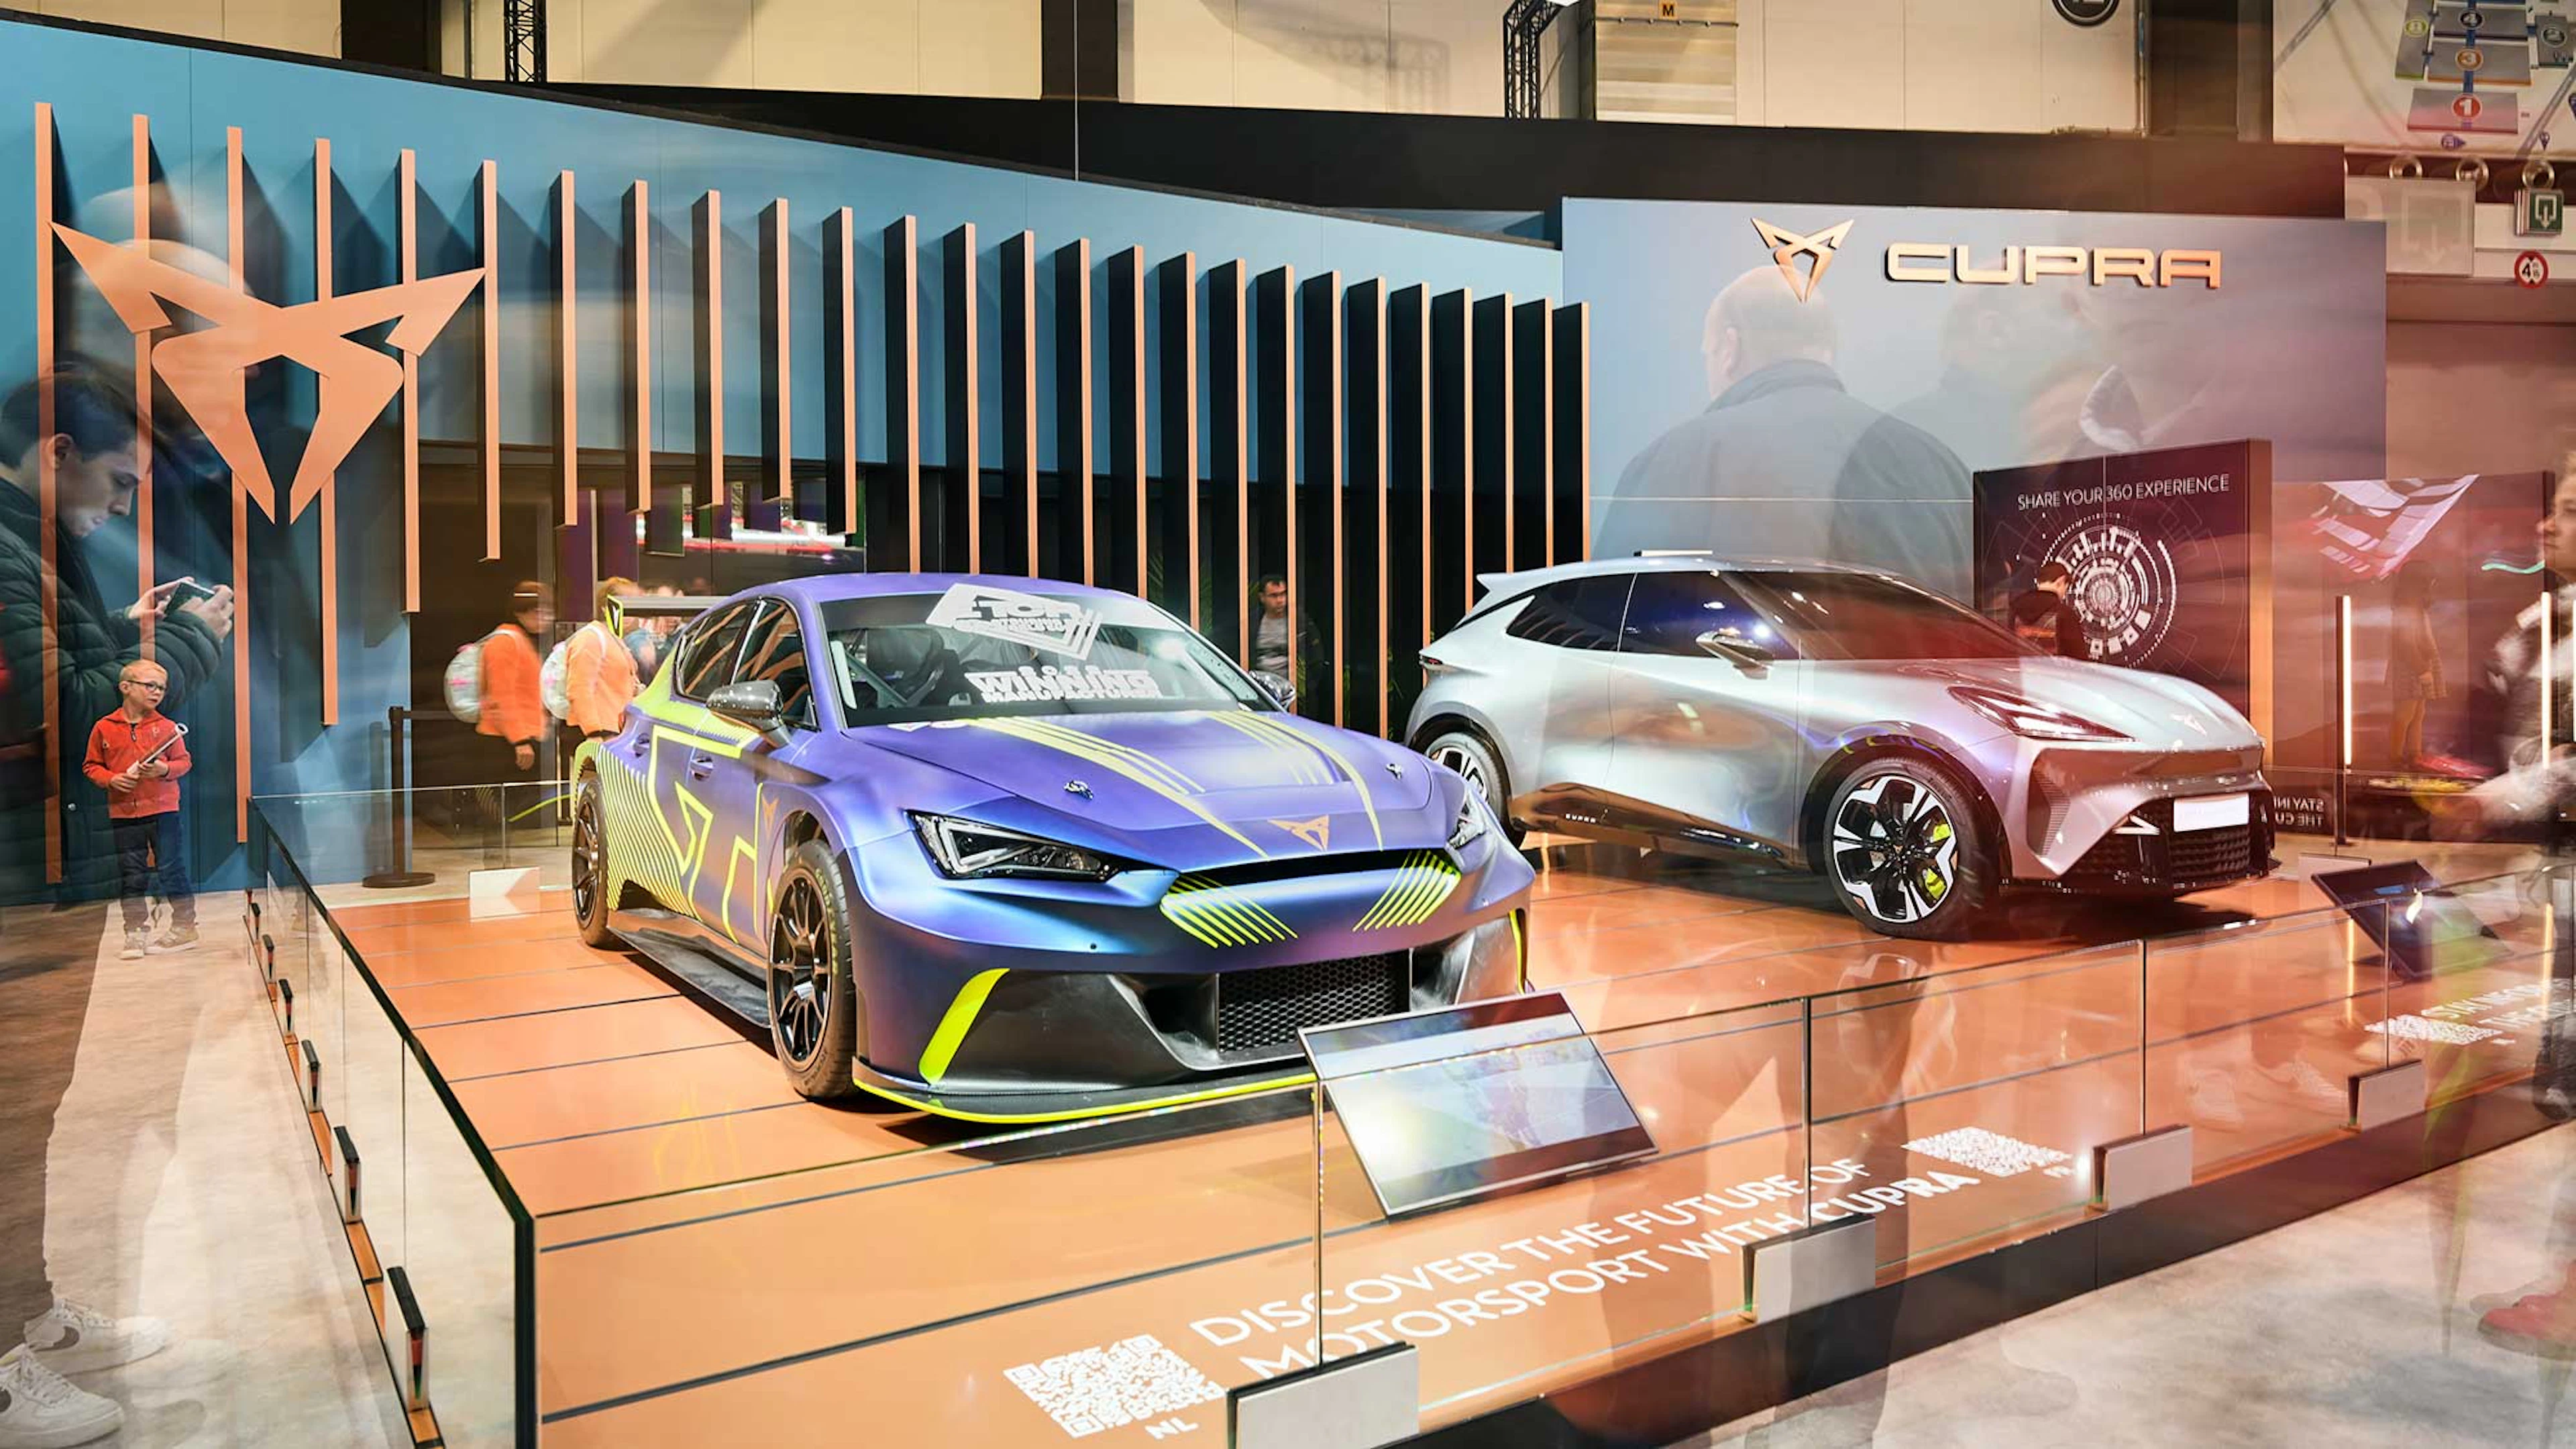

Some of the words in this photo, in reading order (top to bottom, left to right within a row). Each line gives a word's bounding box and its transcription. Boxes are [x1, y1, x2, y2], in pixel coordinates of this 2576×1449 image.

[1662, 4, 1674, 16] M
[2459, 98, 2473, 115] 1
[1885, 242, 2221, 288] CUPRA
[2017, 490, 2061, 511] SHARE
[2063, 486, 2102, 506] YOUR
[2105, 484, 2133, 502] 360
[2136, 473, 2230, 500] EXPERIENCE
[1189, 1250, 1517, 1346] DISCOVER
[1499, 1222, 1631, 1261] THE
[1613, 1174, 1818, 1234] FUTURE
[1809, 1158, 1871, 1184] OF
[1238, 1249, 1670, 1379] MOTORSPORT
[1658, 1212, 1809, 1260] WITH
[1803, 1171, 1981, 1222] CUPRA
[1144, 1417, 1199, 1440] NL
